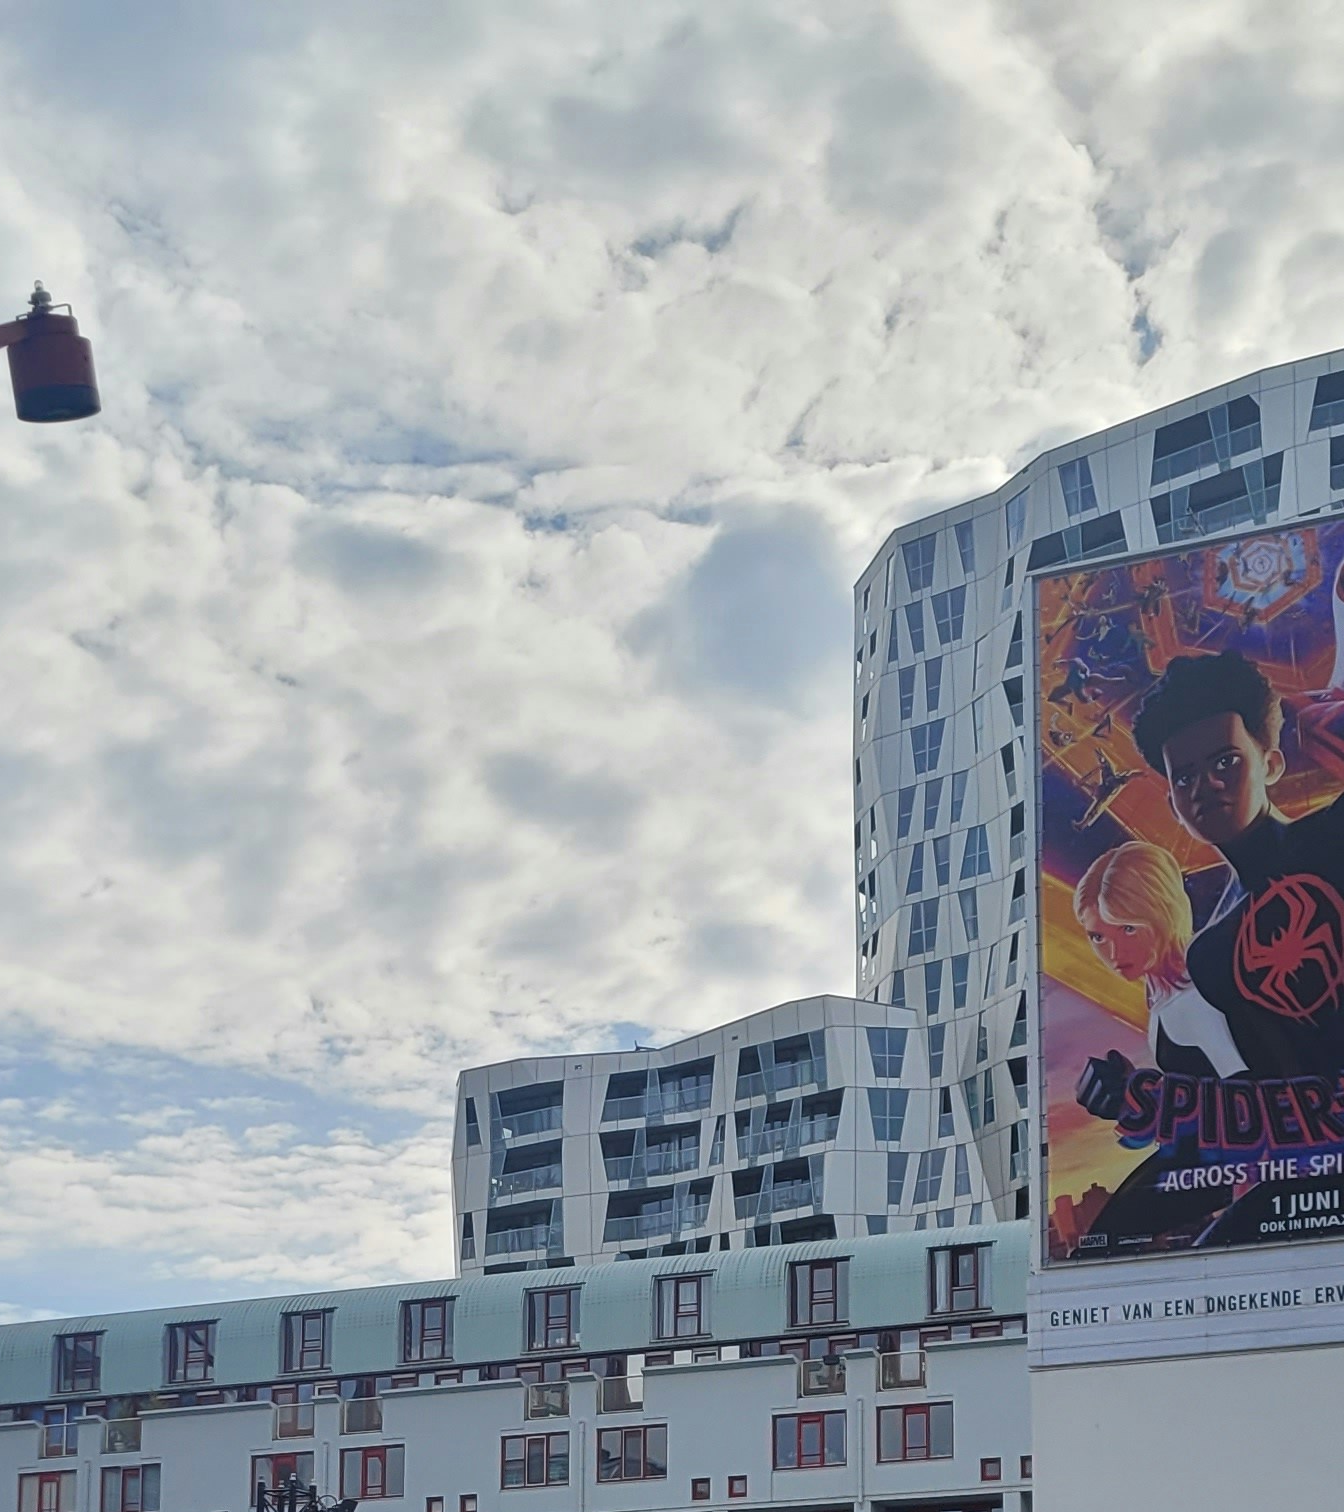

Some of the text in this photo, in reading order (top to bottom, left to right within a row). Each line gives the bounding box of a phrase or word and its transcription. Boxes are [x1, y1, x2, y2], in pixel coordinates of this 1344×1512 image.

[1164, 1164, 1248, 1192] ACROSS
[1258, 1157, 1298, 1183] THE
[1271, 1190, 1340, 1218] 1 JUNI
[1260, 1221, 1286, 1234] OOK
[1289, 1219, 1302, 1231] IN
[1079, 1234, 1107, 1248] MARVEL
[1050, 1306, 1110, 1327] GENIET
[1121, 1301, 1153, 1321] VAN
[1164, 1299, 1195, 1317] EEN
[1206, 1289, 1302, 1314] ONGEKENDE
